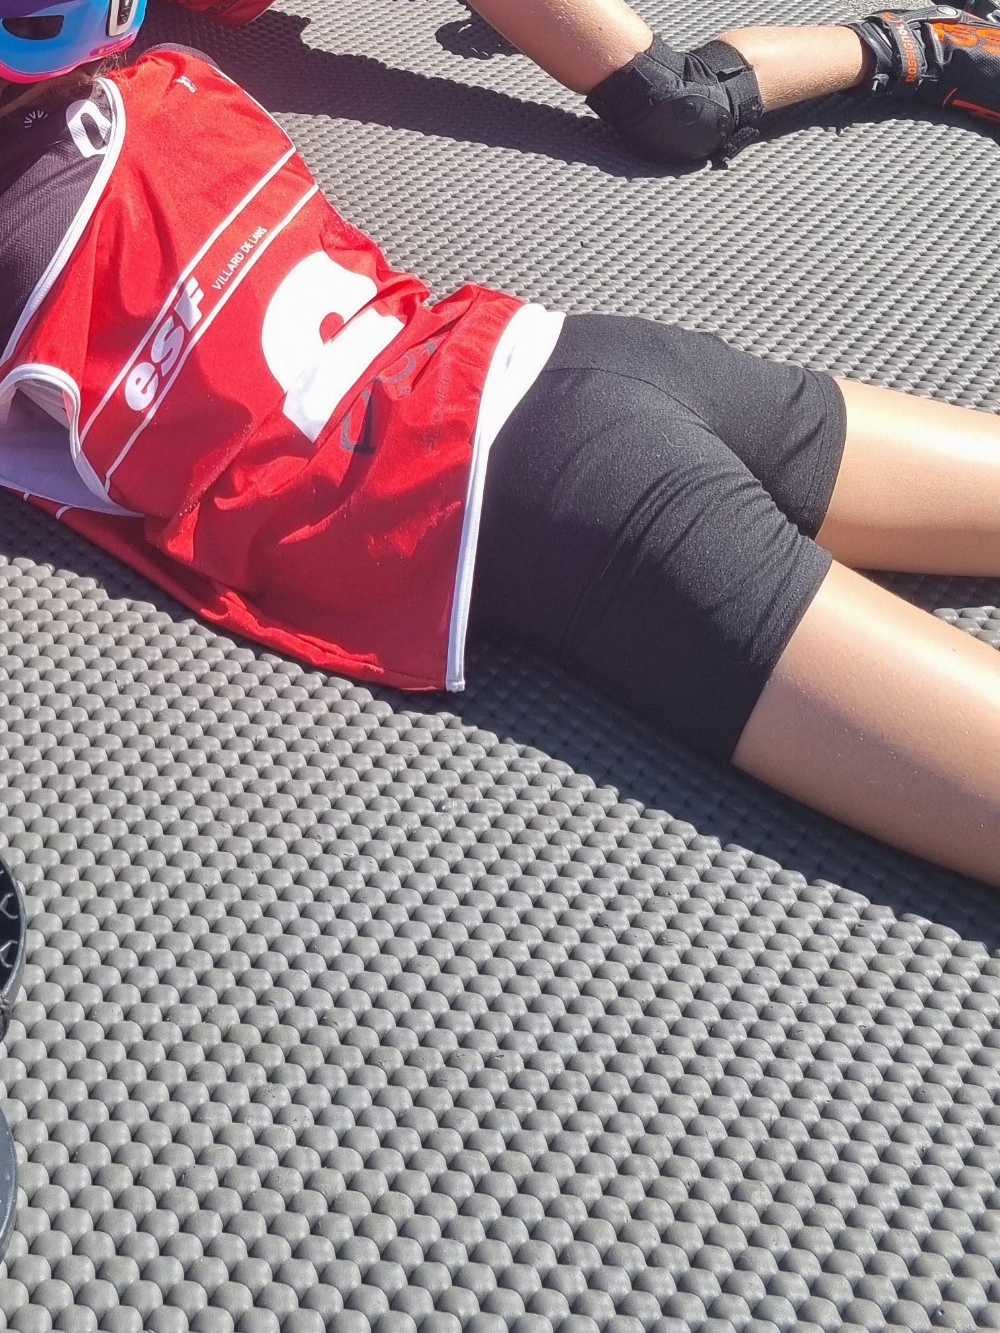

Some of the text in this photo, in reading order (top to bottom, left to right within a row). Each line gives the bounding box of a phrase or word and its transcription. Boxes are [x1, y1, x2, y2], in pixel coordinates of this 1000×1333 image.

[212, 252, 245, 290] VILLARD
[240, 241, 254, 254] DE
[247, 226, 268, 244] LANS
